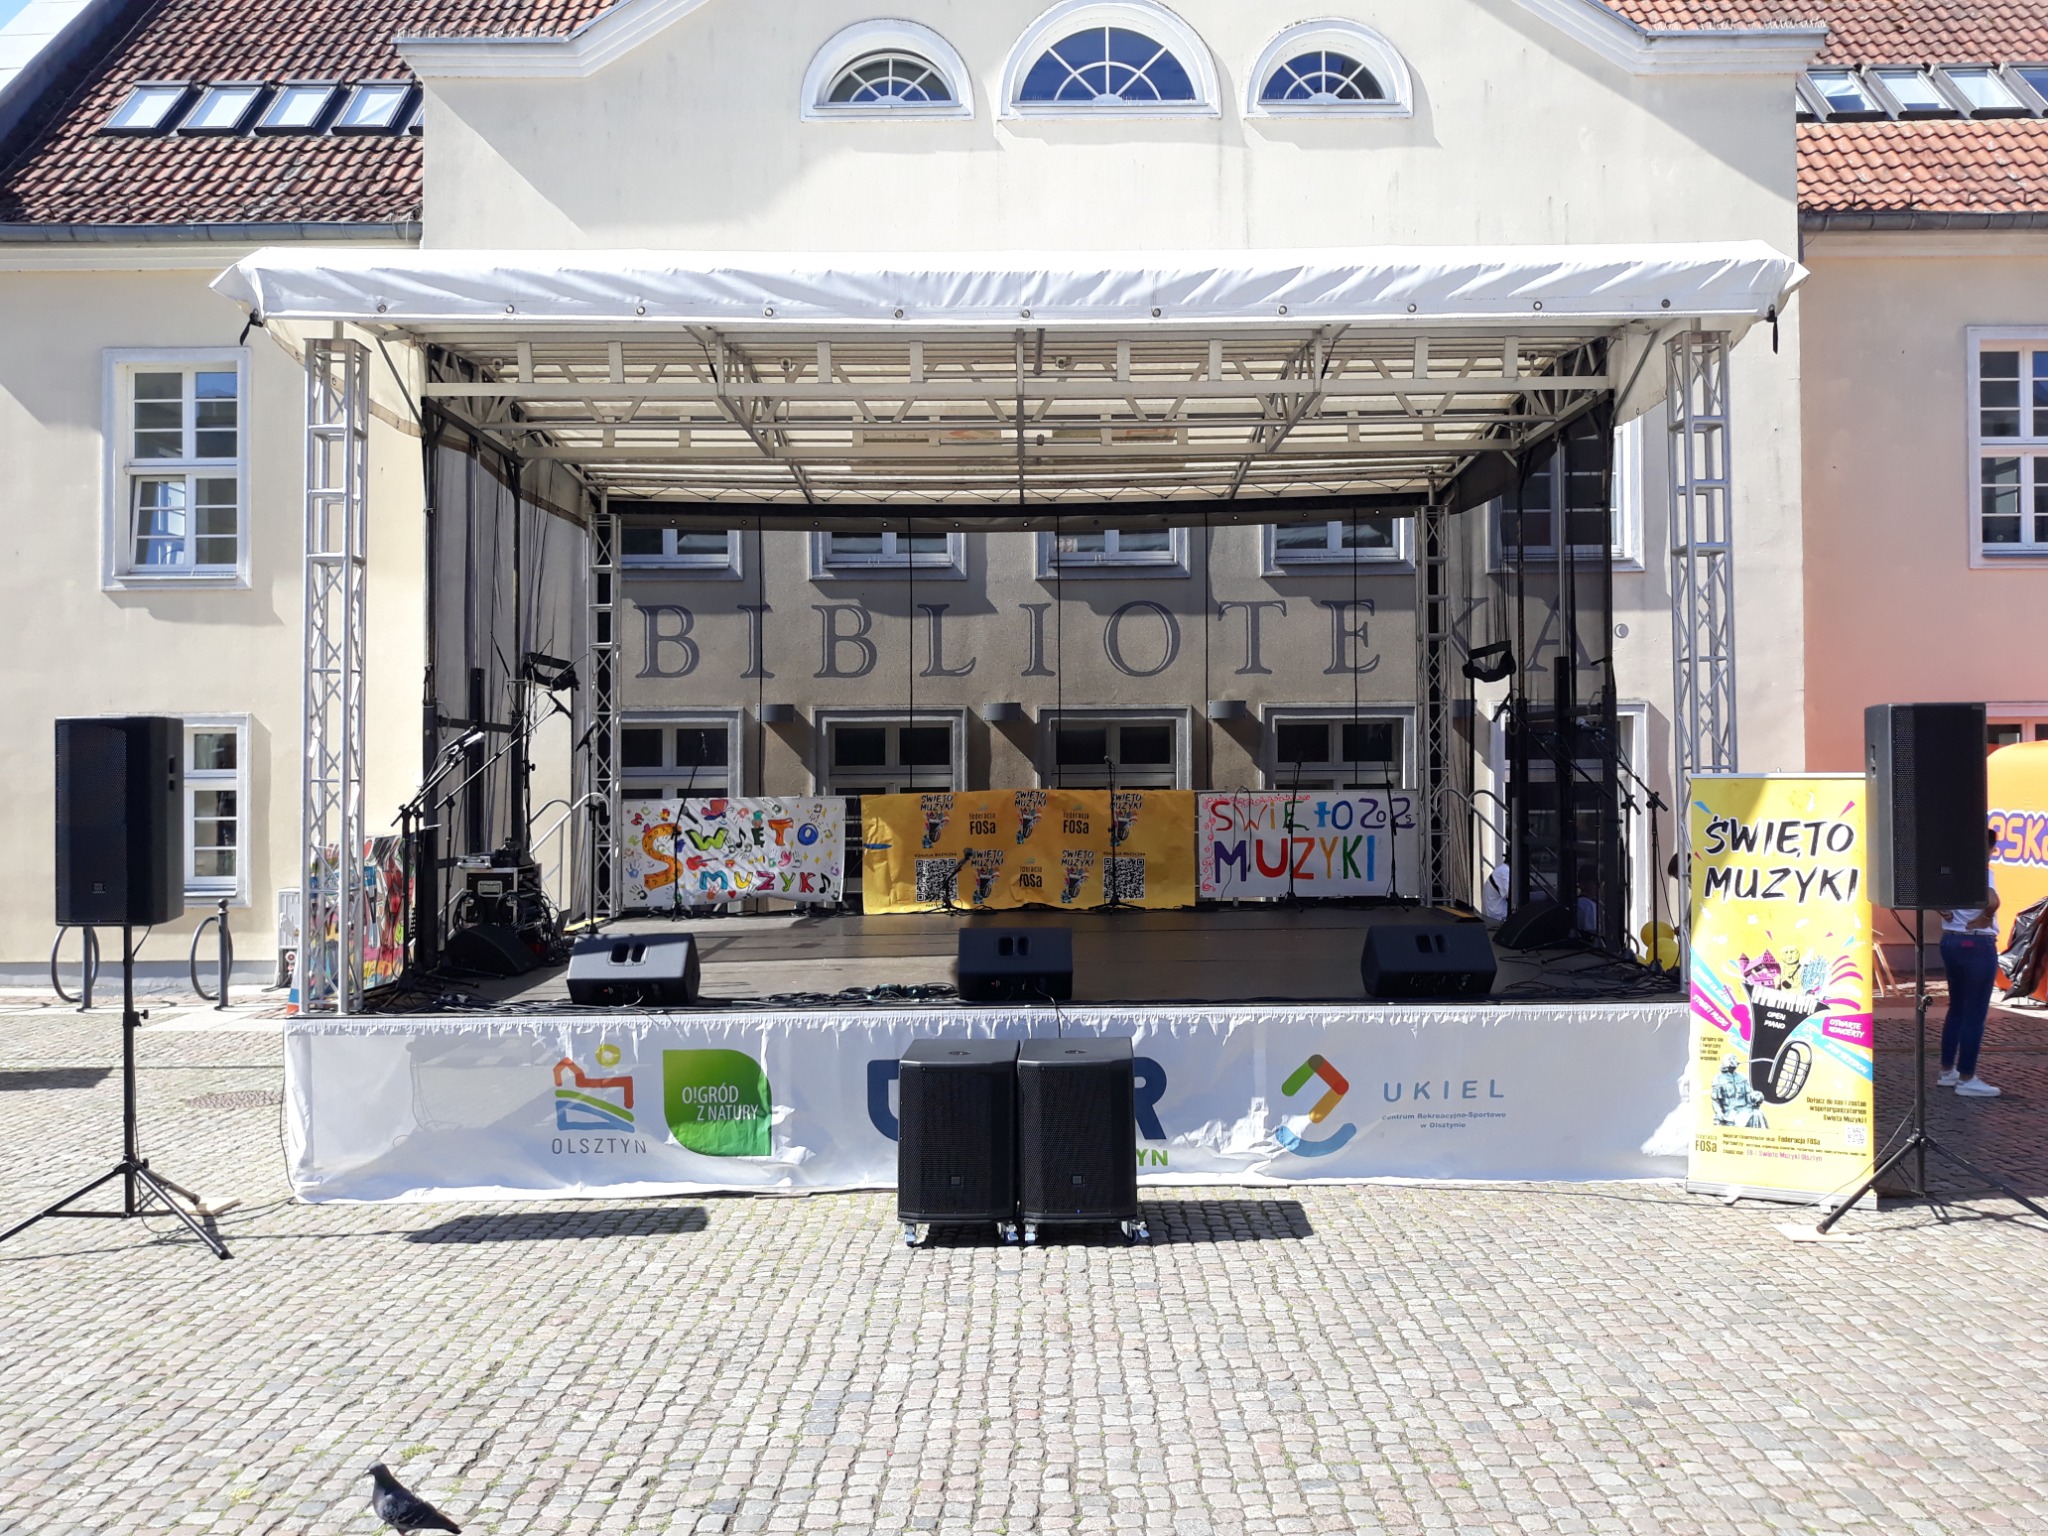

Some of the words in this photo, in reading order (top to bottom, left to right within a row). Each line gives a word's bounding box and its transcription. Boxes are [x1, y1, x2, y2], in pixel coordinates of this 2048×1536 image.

[969, 820, 996, 836] FOSa
[1063, 820, 1089, 834] FOSa
[1705, 815, 1855, 858] ŚWIĘTO
[1214, 835, 1376, 883] MUZYKI
[1704, 866, 1859, 903] MUZYKI
[1766, 1011, 1786, 1020] OPEN
[1764, 1019, 1786, 1029] PIANO
[1383, 1079, 1505, 1102] UKIEL
[696, 1105, 705, 1121] Z
[708, 1104, 759, 1121] NATURY
[551, 1138, 647, 1154] OLSZTYN
[1695, 1140, 1718, 1153] FOSa
